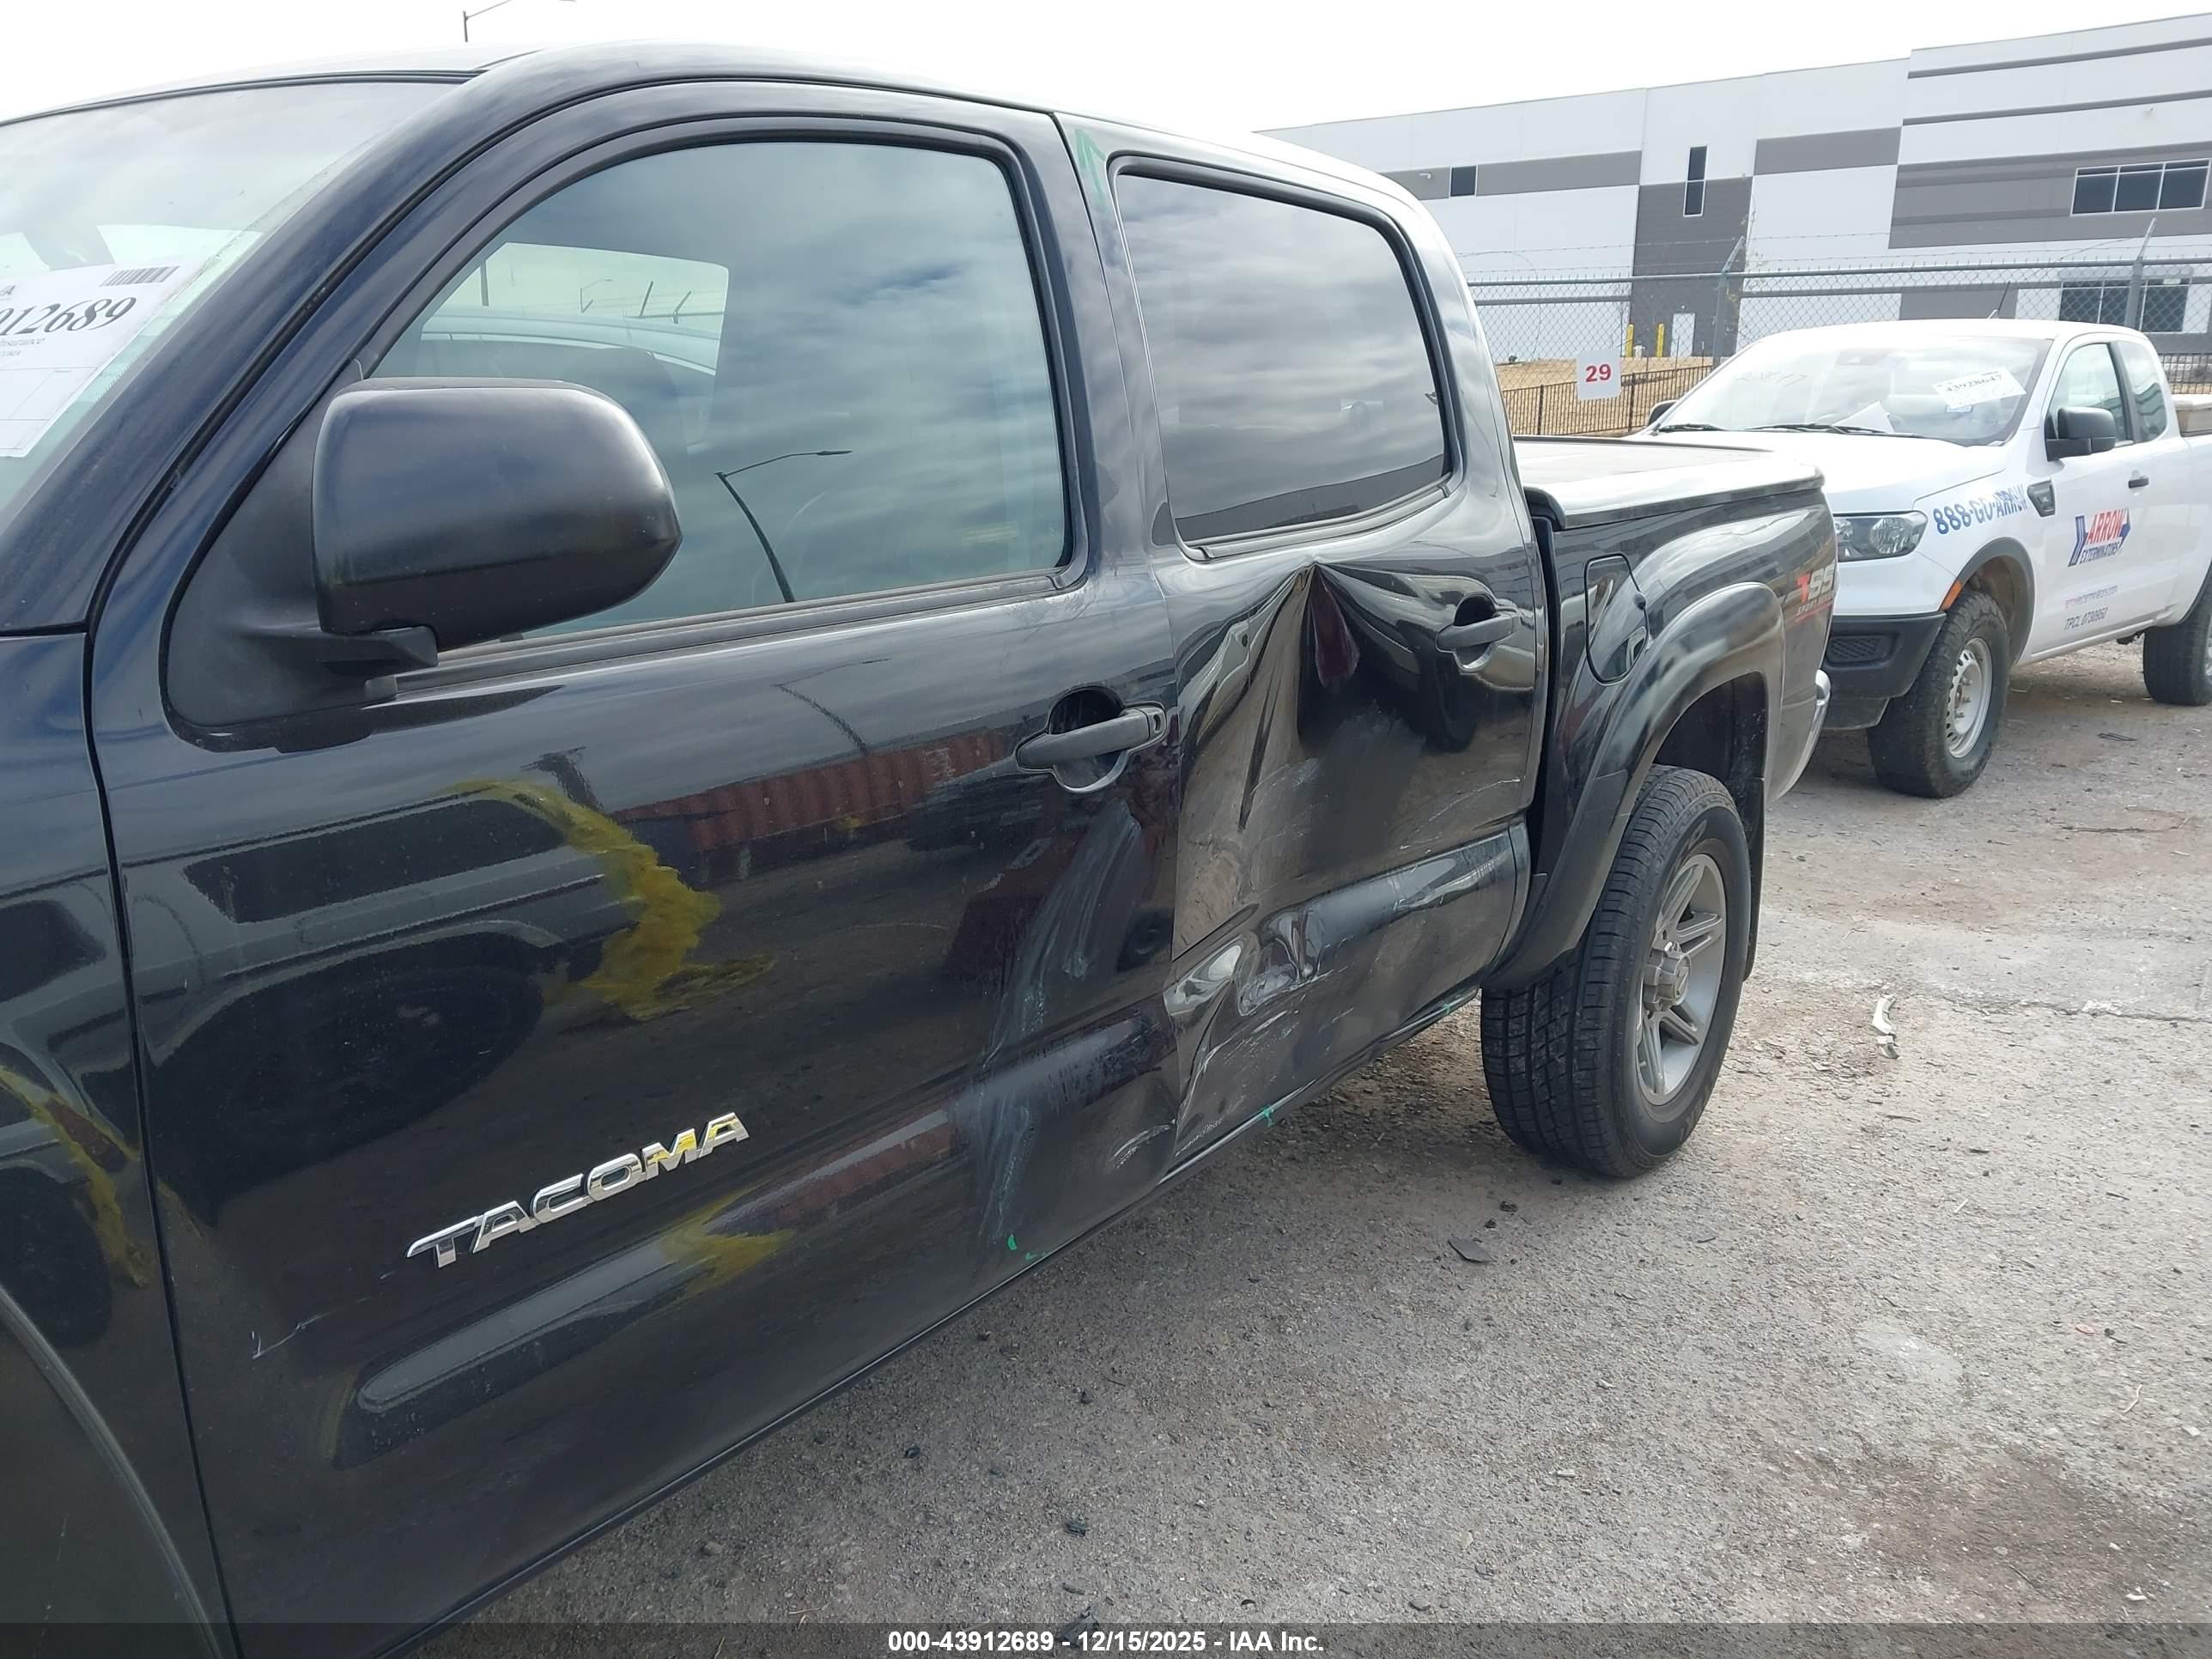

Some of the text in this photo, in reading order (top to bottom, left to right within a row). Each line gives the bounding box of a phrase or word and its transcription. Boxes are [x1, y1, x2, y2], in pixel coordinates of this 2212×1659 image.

[1585, 363, 1611, 382] 29
[2086, 507, 2125, 544] ARROW
[406, 1112, 749, 1268] TACOMA
